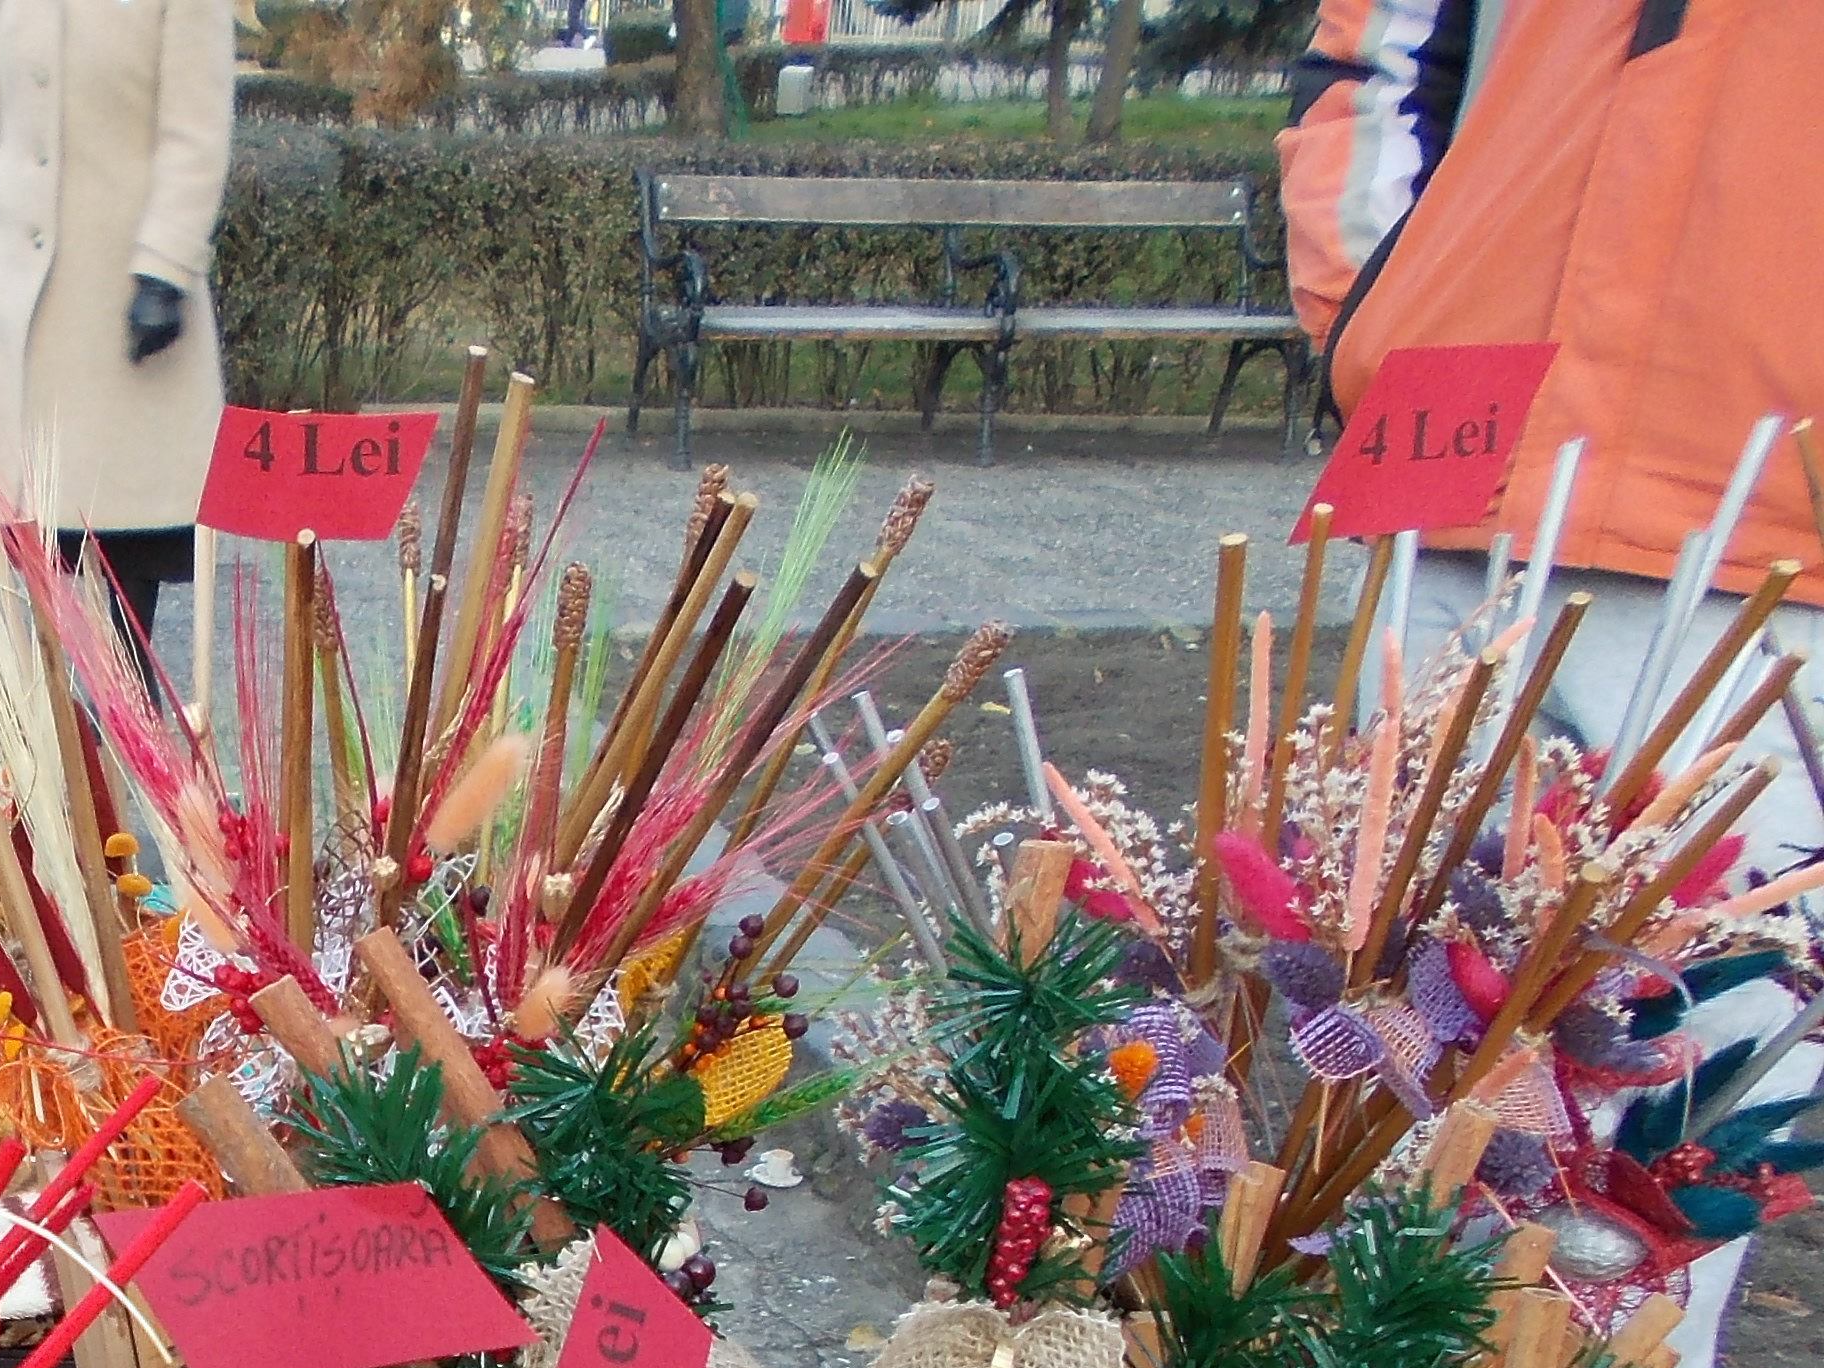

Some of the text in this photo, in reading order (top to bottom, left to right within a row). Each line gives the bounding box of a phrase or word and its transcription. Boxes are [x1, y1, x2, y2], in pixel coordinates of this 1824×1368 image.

[243, 420, 402, 477] 4 Lei
[1358, 400, 1500, 466] 4 Lei
